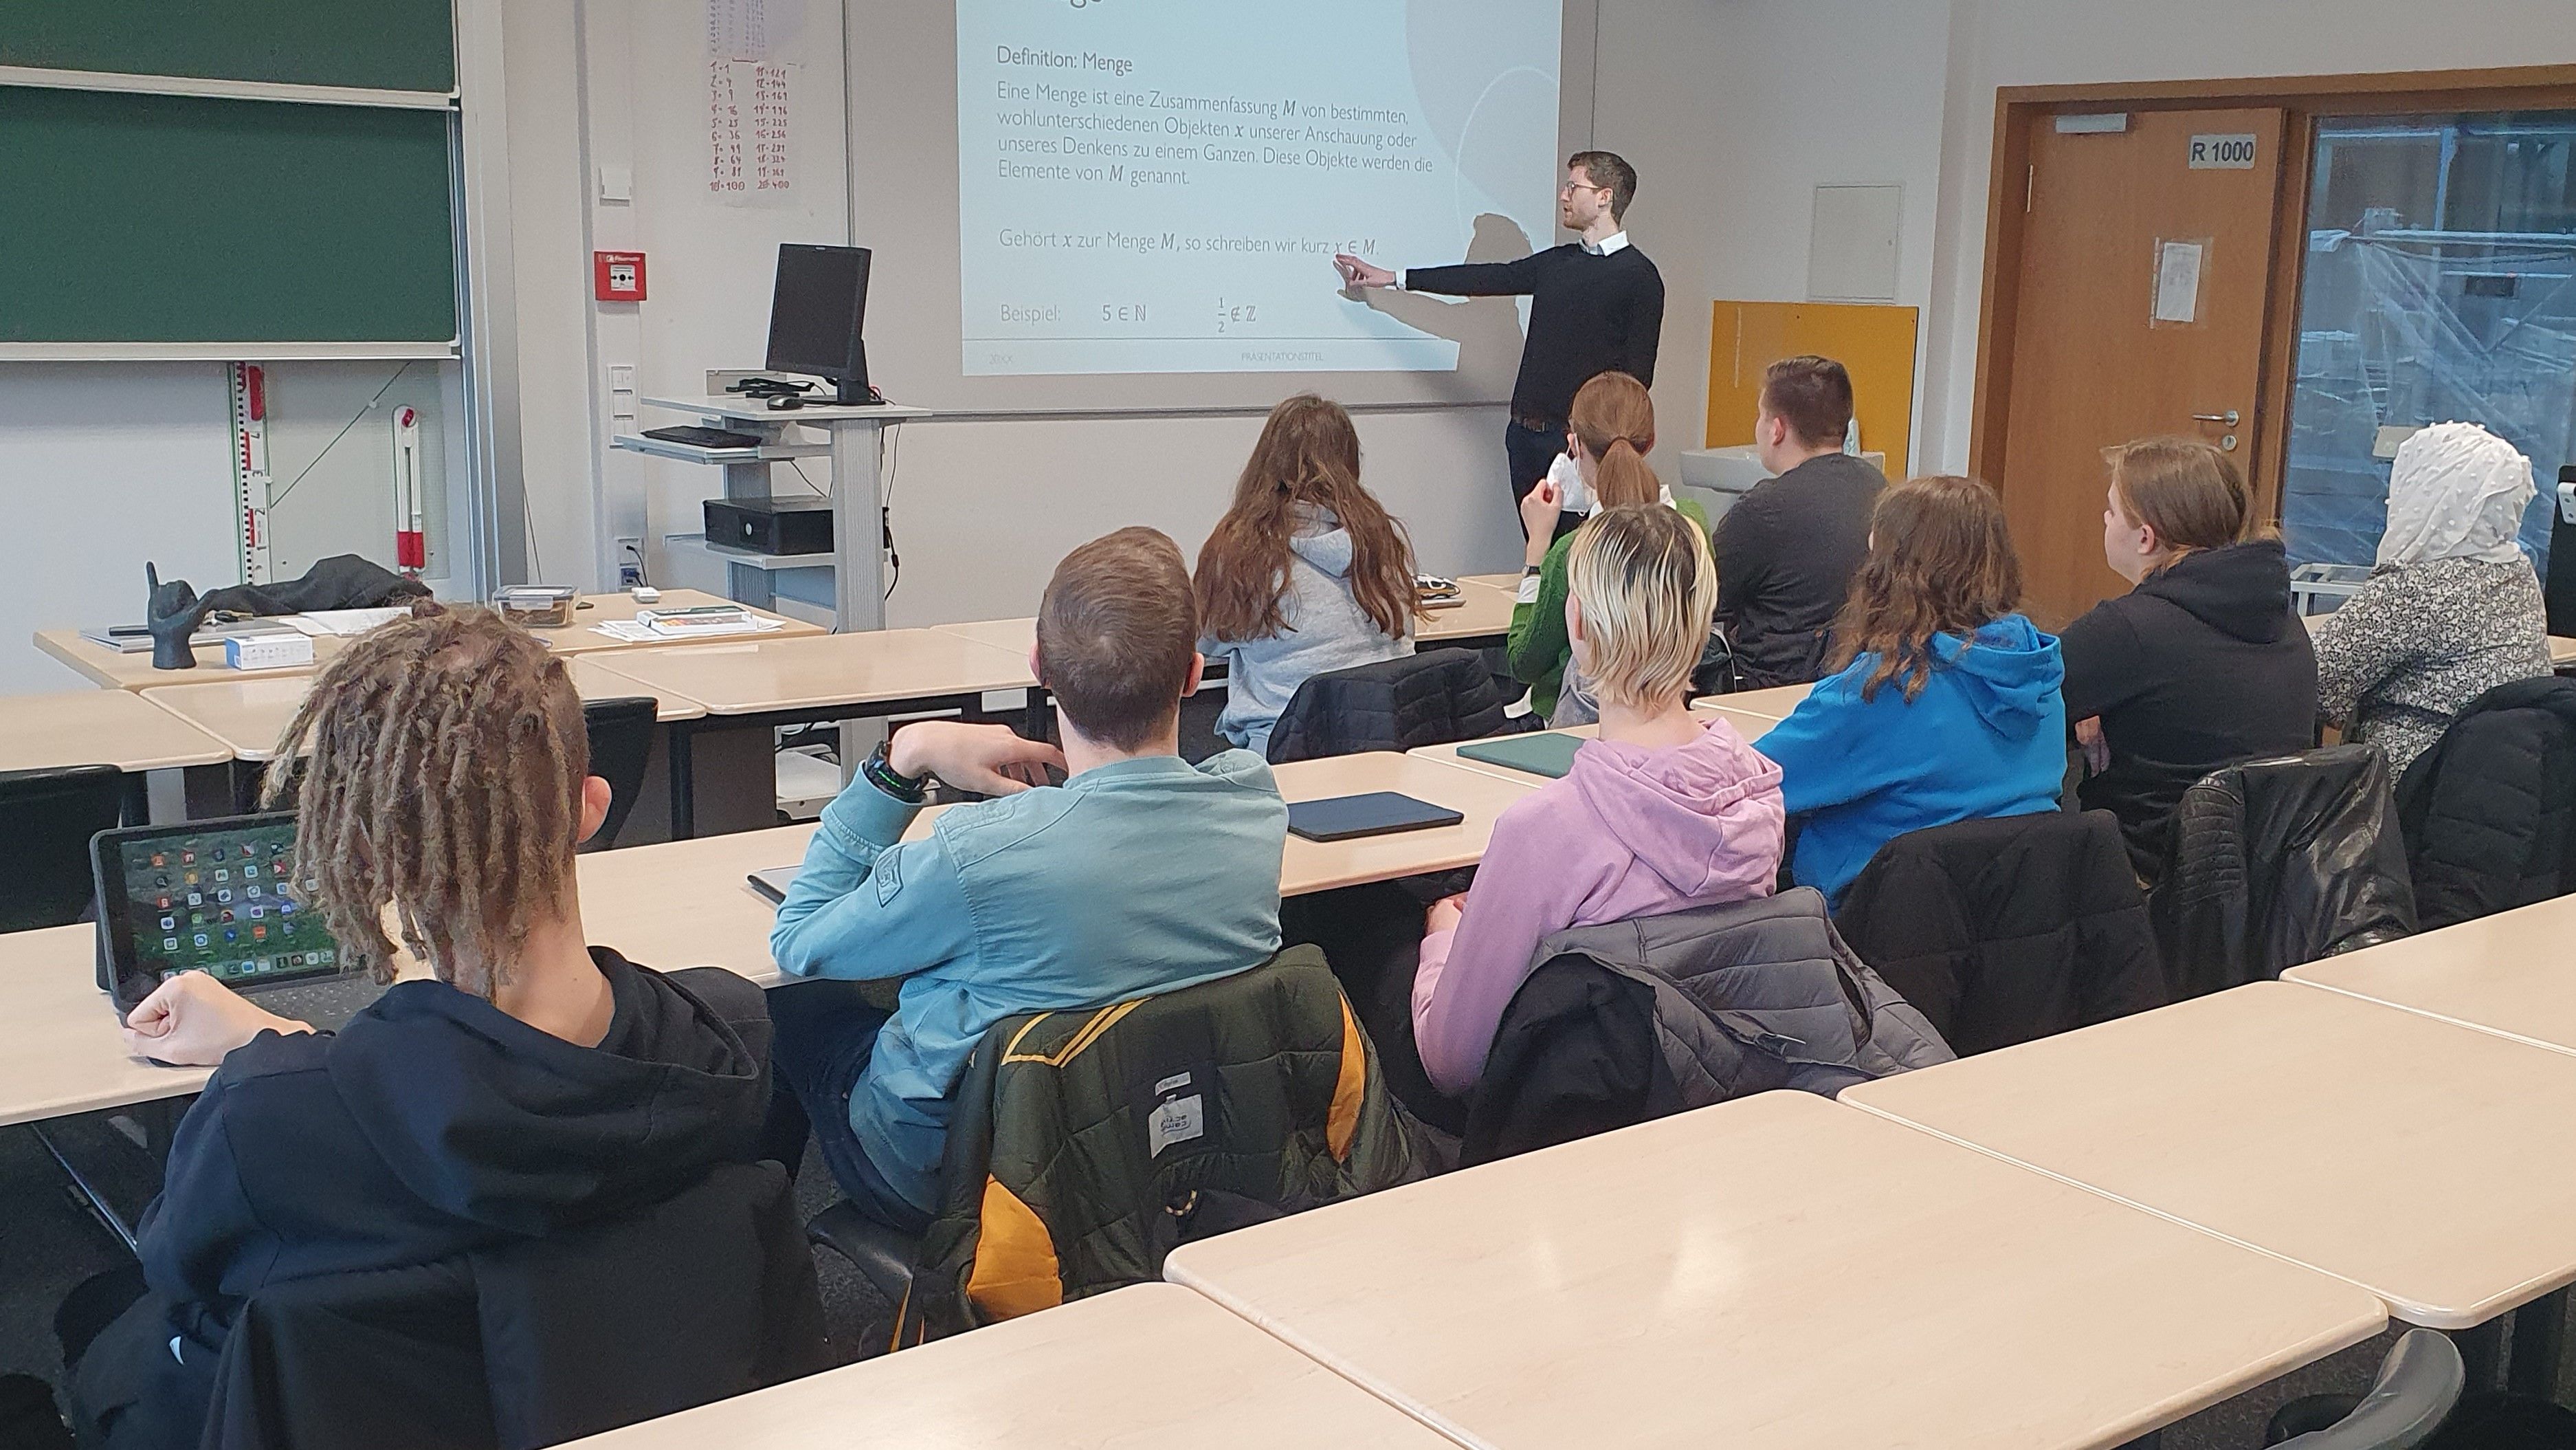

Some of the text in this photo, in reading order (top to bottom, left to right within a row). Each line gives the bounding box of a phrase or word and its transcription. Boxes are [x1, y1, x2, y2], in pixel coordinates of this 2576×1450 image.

[997, 45, 1133, 76] Definition: Menge
[997, 81, 1409, 125] Eine Menge ist eine Zusammenfassung M von bestimmten,
[997, 109, 1417, 151] wohlunterschiedenen Objekten x unserer Anschauung oder
[998, 138, 1433, 172] unseres Denkens zu einem Ganzen. Diese Objekte werden die
[2191, 141, 2254, 162] R 1000
[999, 160, 1190, 187] Elemente von M genannt.
[999, 229, 1057, 248] Gehört
[1063, 234, 1072, 248] x
[1078, 235, 1101, 248] zur
[1107, 232, 1155, 254] Menge
[1185, 238, 1201, 250] so
[1206, 234, 1270, 252] schreiben
[1275, 240, 1296, 252] wir
[1302, 238, 1329, 254] kurz
[1001, 305, 1061, 326] Beispiel:
[1102, 305, 1111, 321] 5
